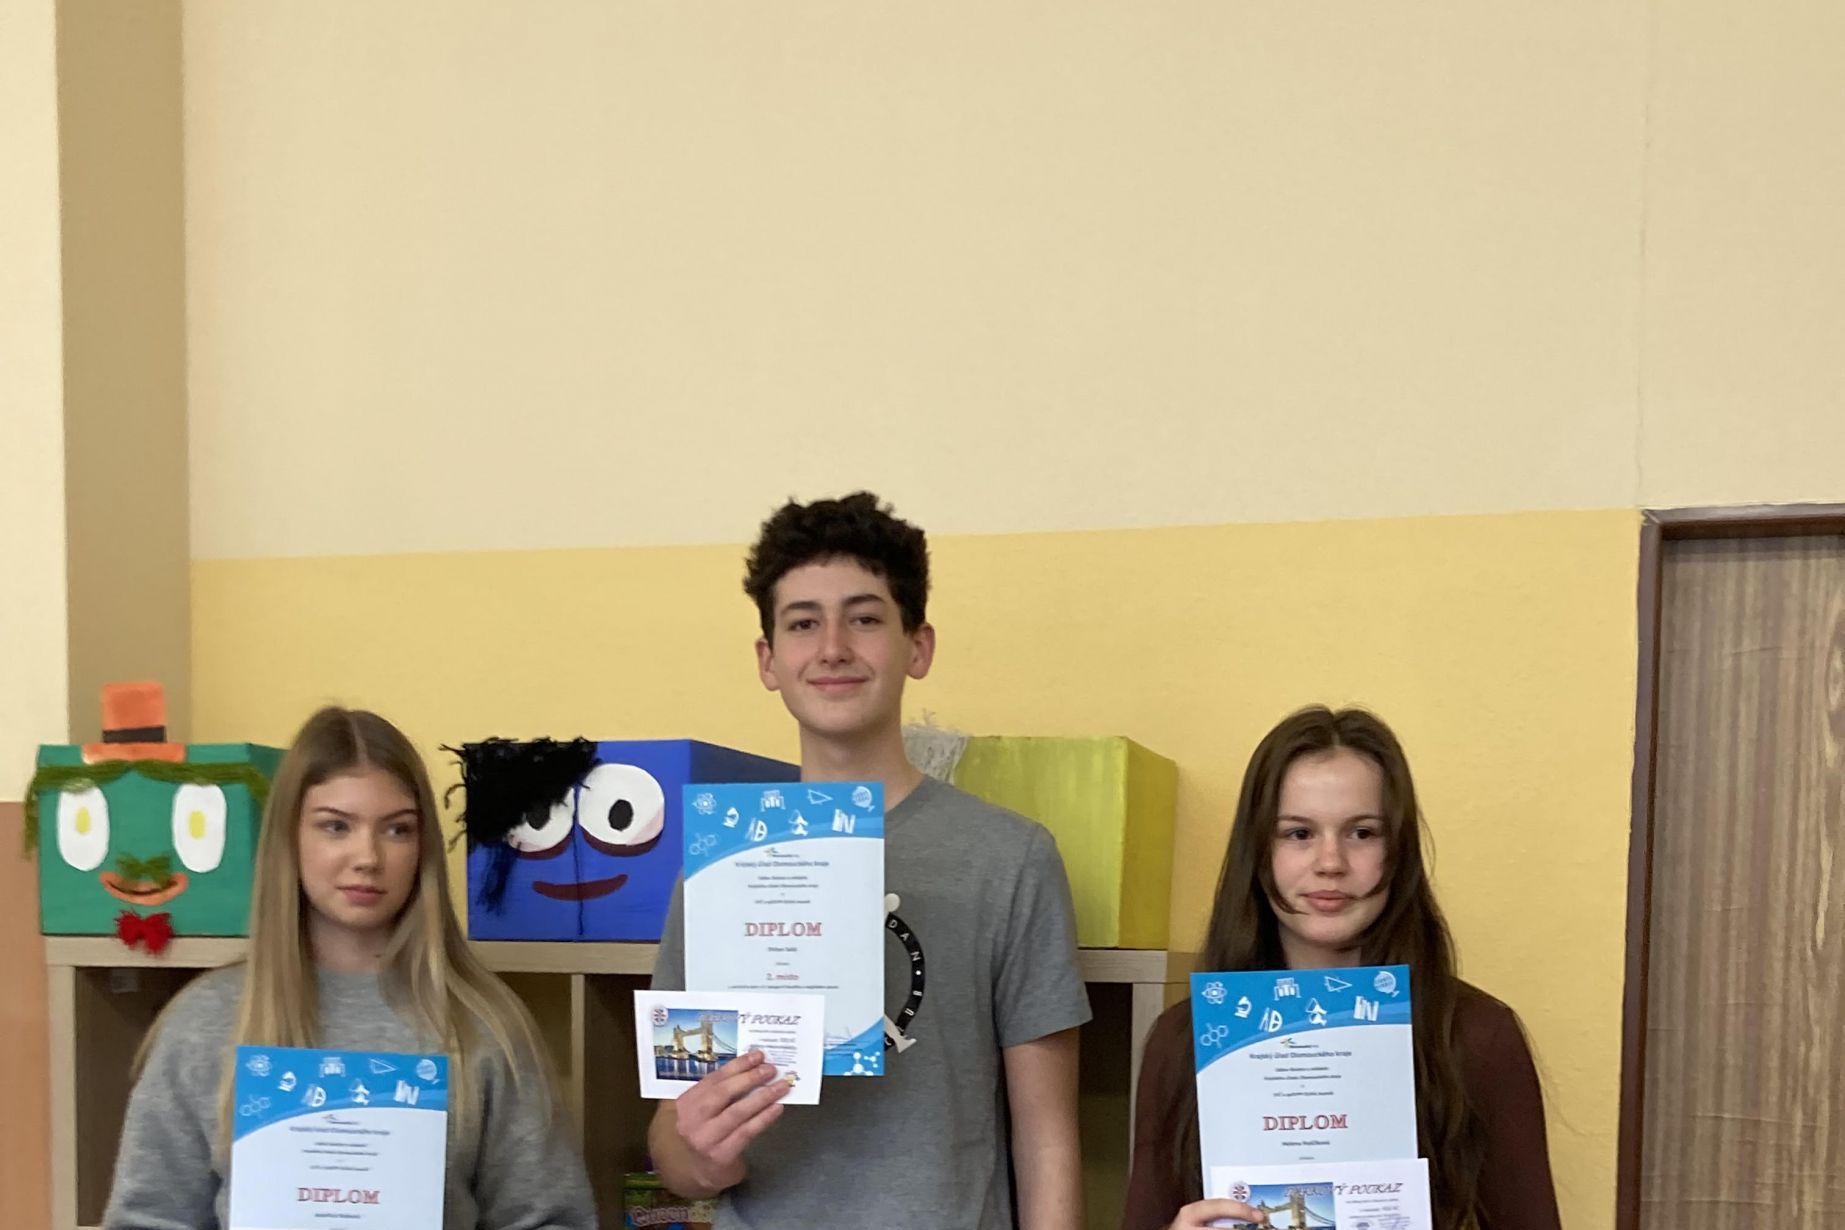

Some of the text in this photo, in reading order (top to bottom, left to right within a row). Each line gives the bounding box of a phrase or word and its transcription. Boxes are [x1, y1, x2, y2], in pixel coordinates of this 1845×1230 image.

[744, 922, 822, 937] DIPLOM
[1262, 1113, 1349, 1131] DIPLOM
[297, 1187, 381, 1205] DIPLOM
[1349, 1182, 1404, 1196] POUKAZ
